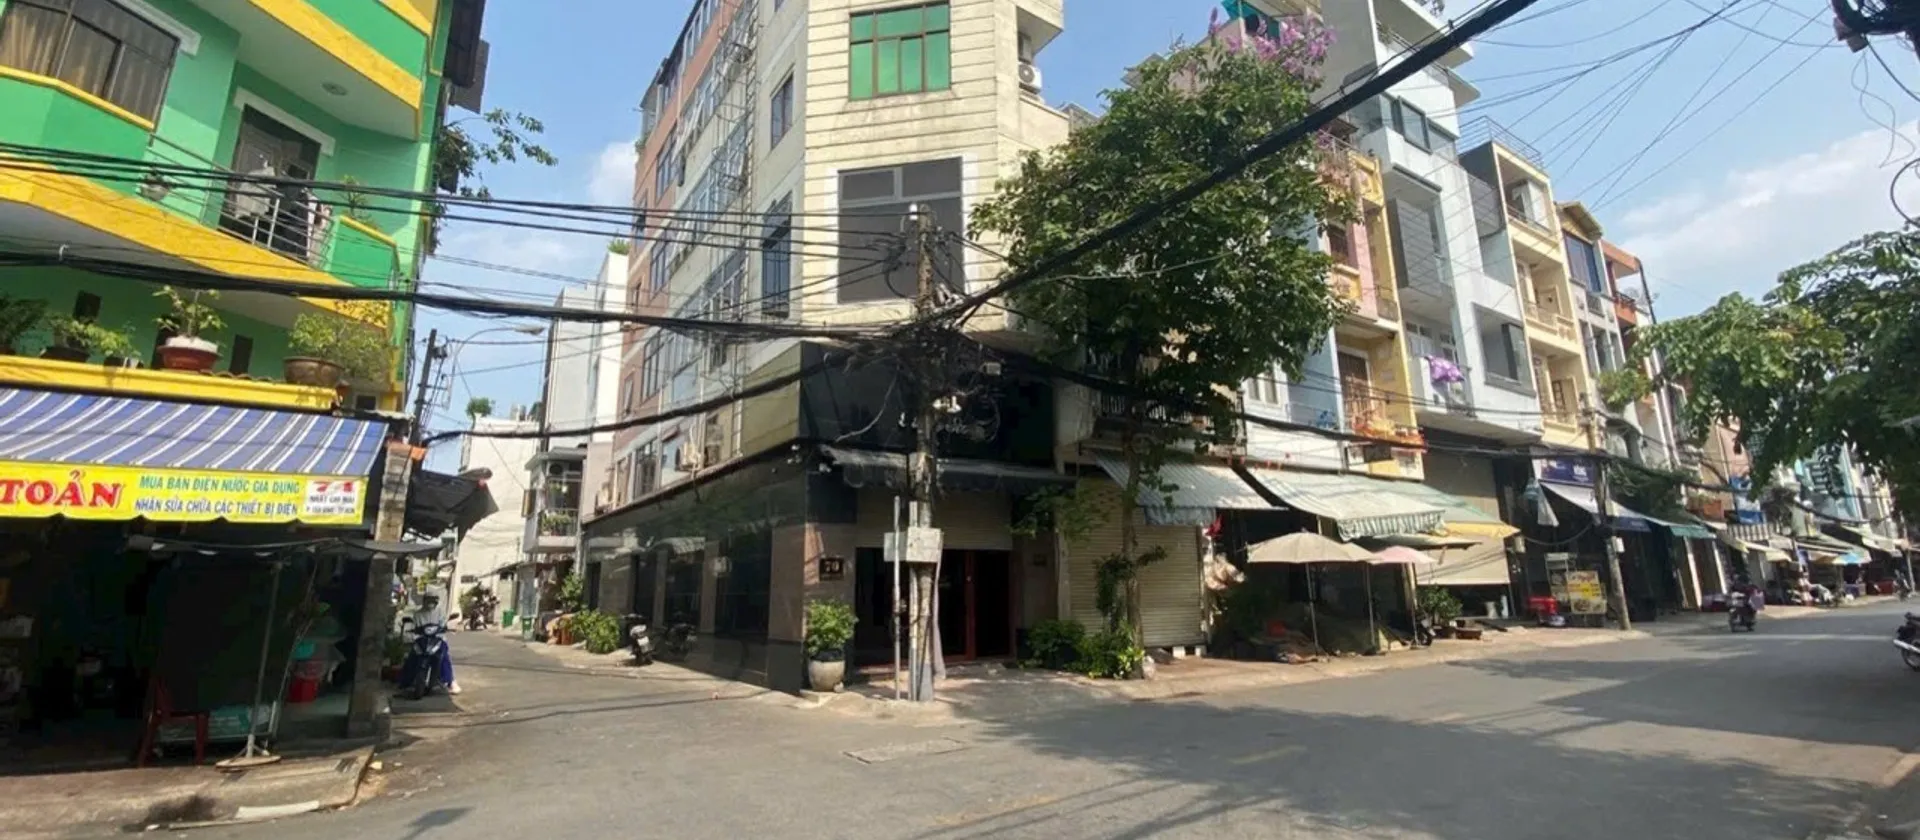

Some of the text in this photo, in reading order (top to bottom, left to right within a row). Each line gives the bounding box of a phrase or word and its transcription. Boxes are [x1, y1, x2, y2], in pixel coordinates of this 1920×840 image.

[0, 469, 123, 508] TOẢN
[140, 475, 163, 489] MUA
[253, 480, 269, 493] GIA
[214, 498, 234, 514] CÁC
[236, 498, 261, 515] THIẾT
[264, 502, 275, 517] BỊ
[824, 560, 840, 573] 70
